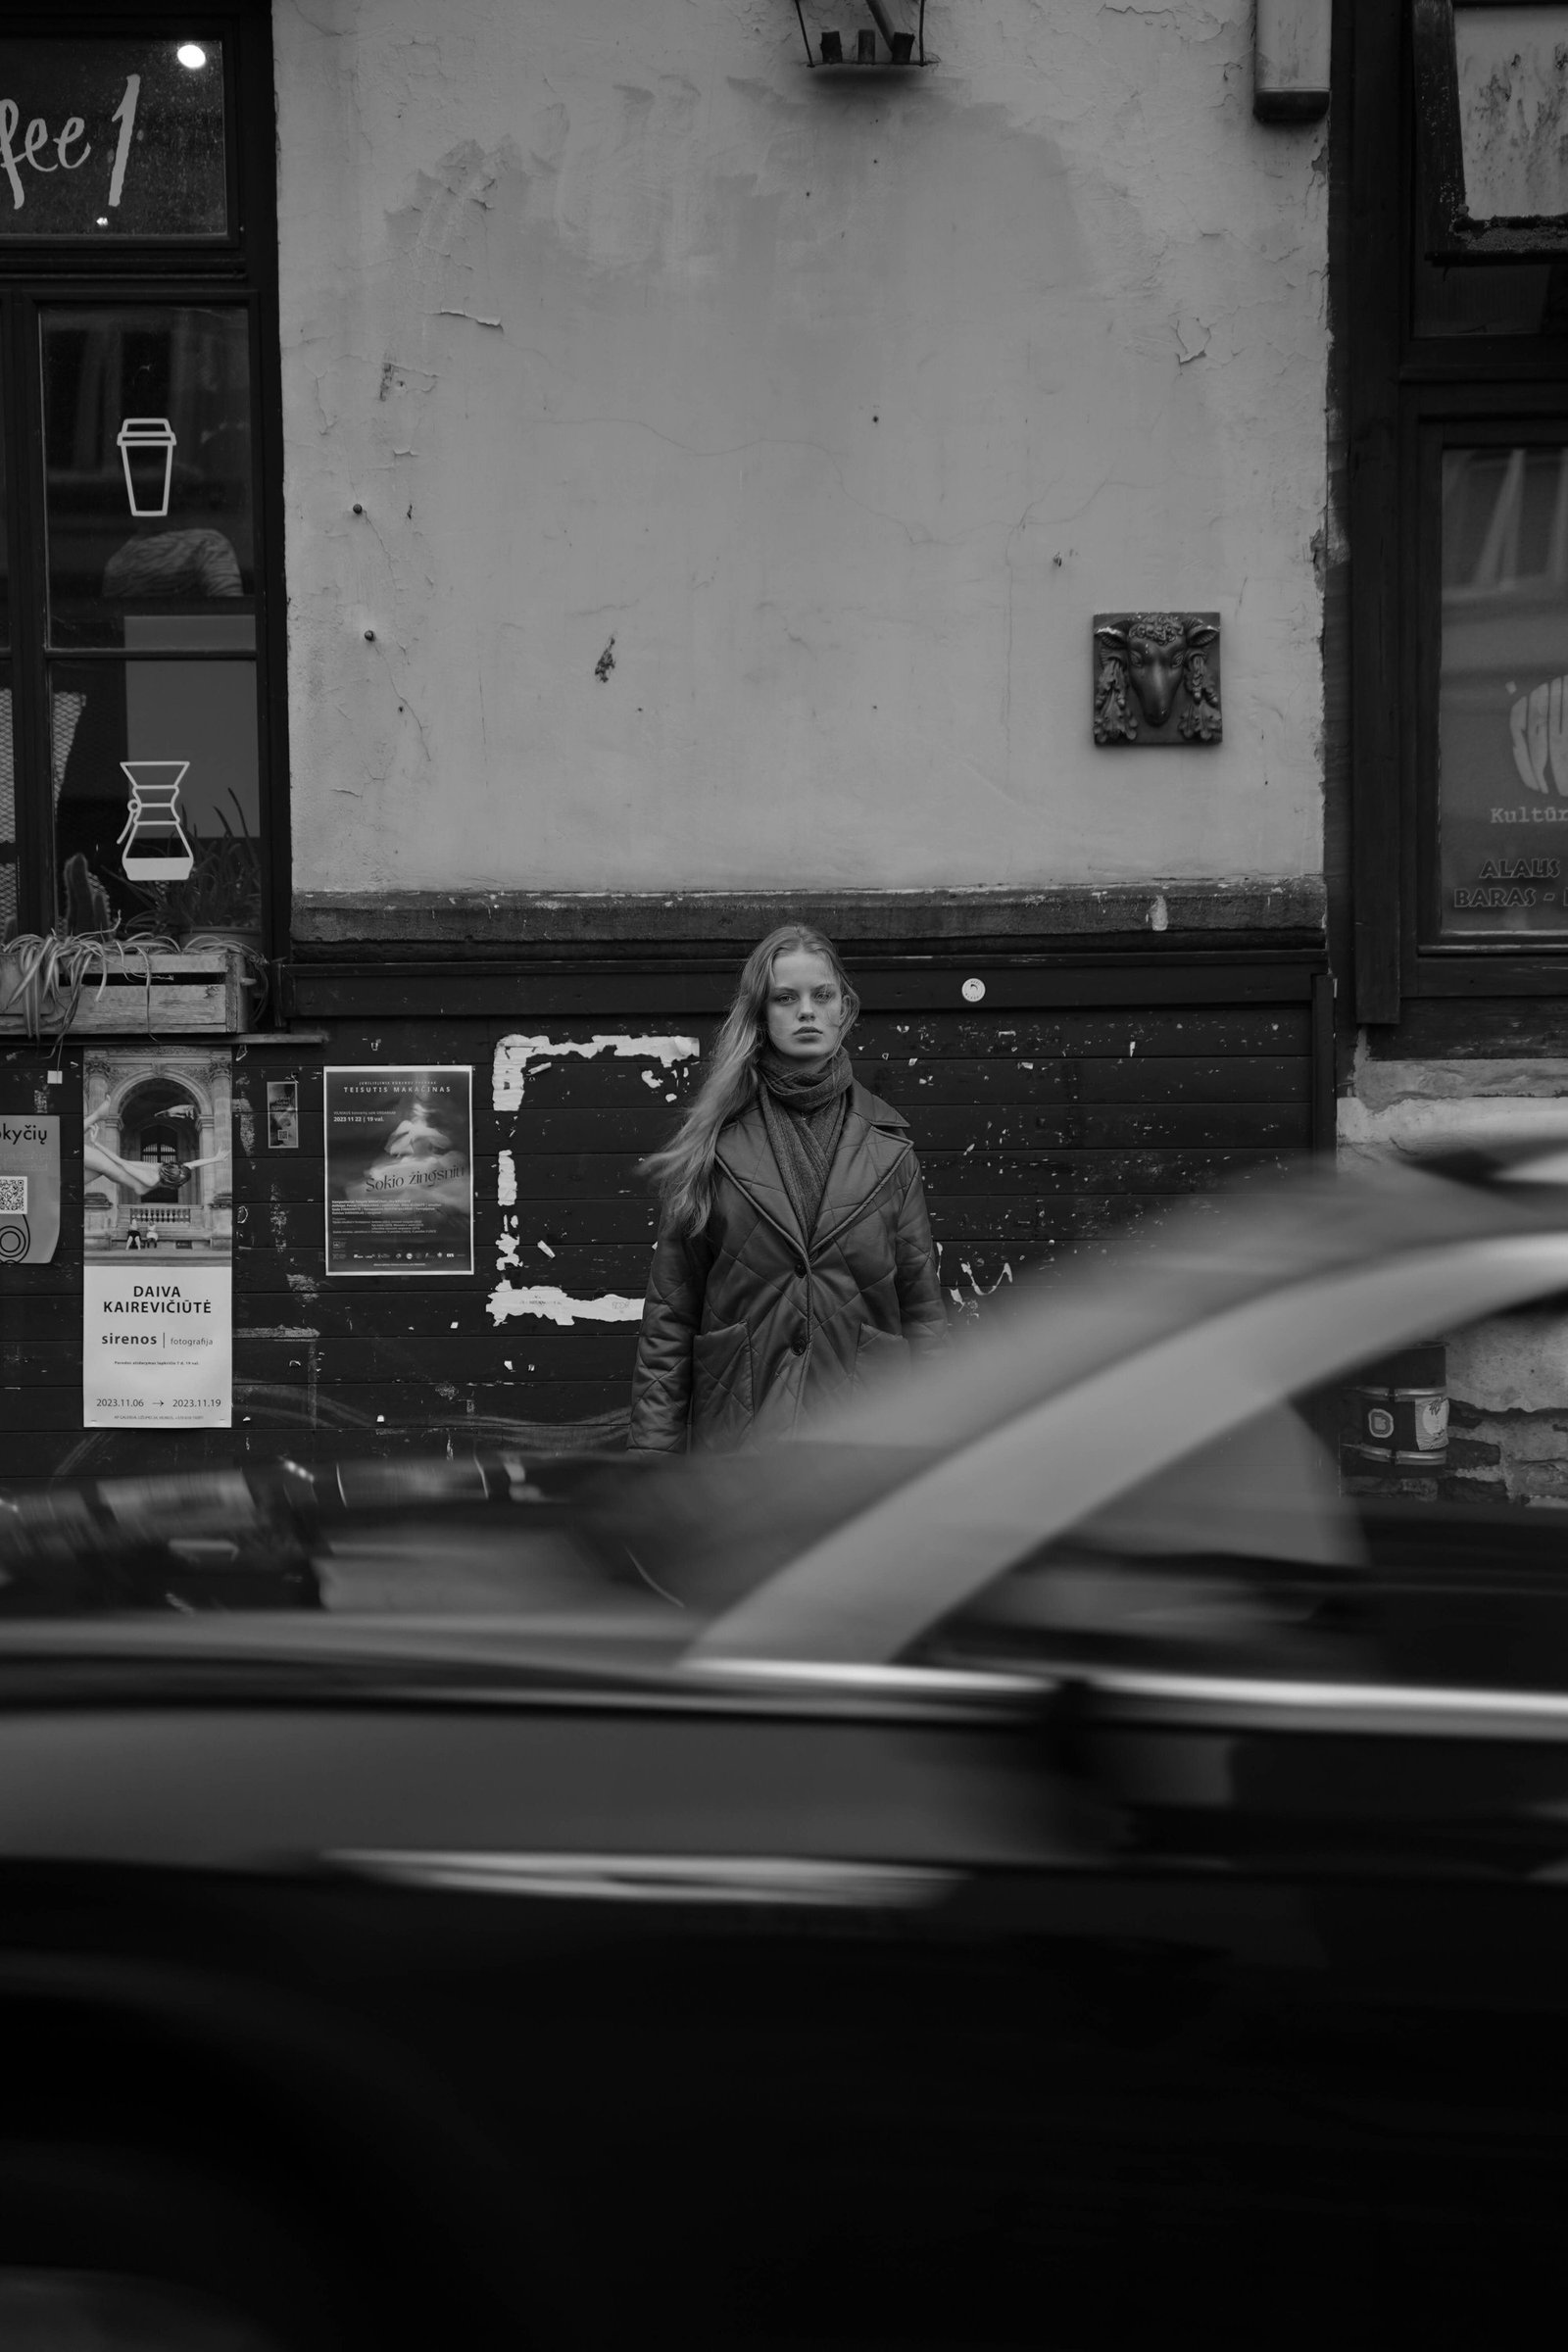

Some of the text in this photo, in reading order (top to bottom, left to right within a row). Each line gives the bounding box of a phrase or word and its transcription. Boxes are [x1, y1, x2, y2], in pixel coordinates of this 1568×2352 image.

[1479, 858, 1560, 878] ALAUS
[1453, 887, 1537, 907] BARAS
[0, 1123, 47, 1145] kyčių
[133, 1286, 181, 1298] DAIVA
[103, 1298, 212, 1313] KAIREVIČIŪTĖ
[101, 1333, 214, 1347] sirenos fotografija
[96, 1398, 221, 1407] 2023.11.06 2023.11.19
